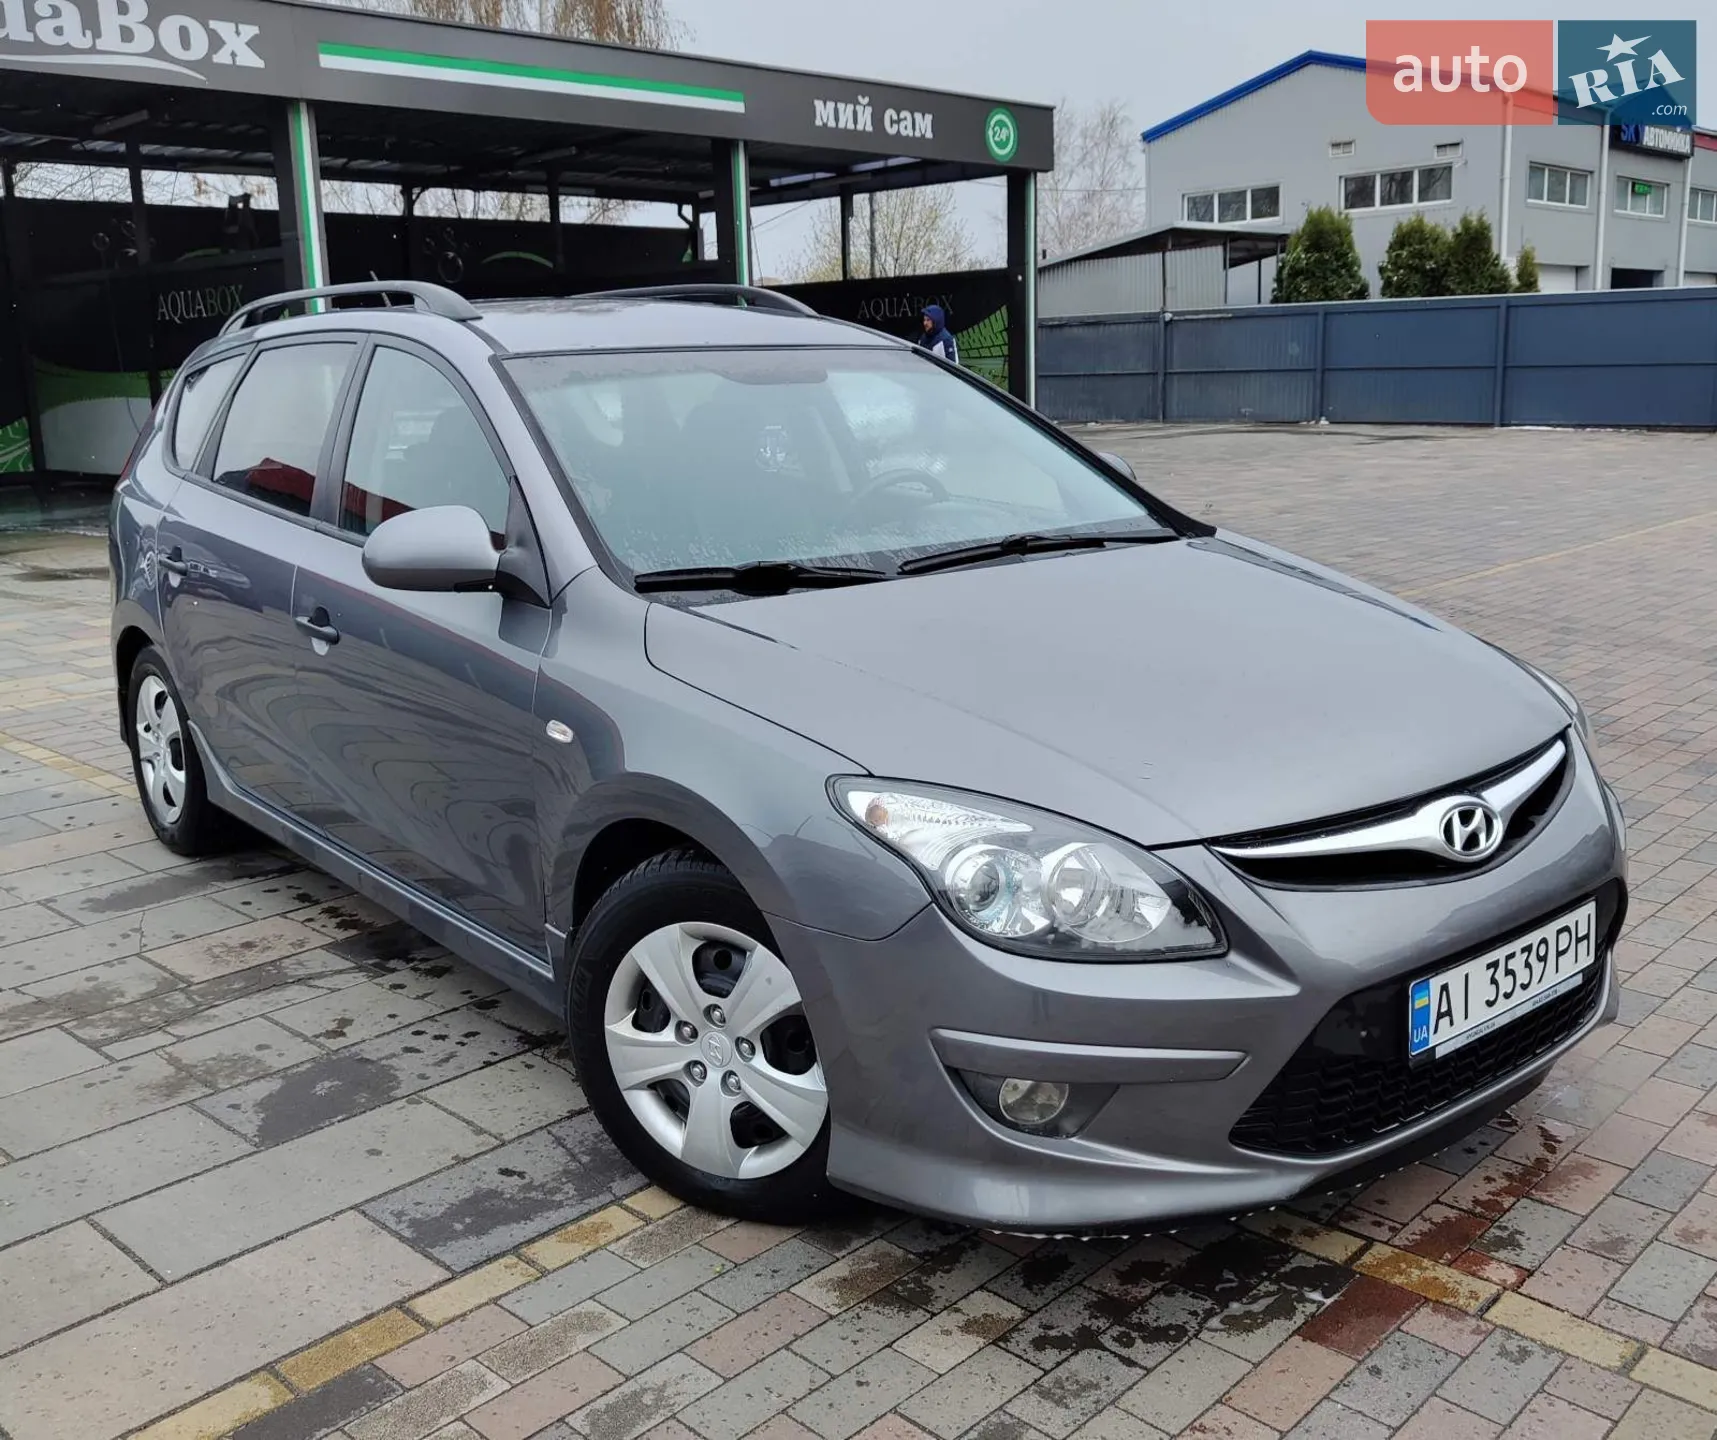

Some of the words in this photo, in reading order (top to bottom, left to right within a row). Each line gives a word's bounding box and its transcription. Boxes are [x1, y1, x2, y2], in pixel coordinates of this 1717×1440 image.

[813, 95, 873, 132] мий
[883, 108, 934, 139] сам
[157, 284, 243, 324] AQUABOX
[1433, 972, 1469, 1035] AI
[1413, 1027, 1428, 1043] UA
